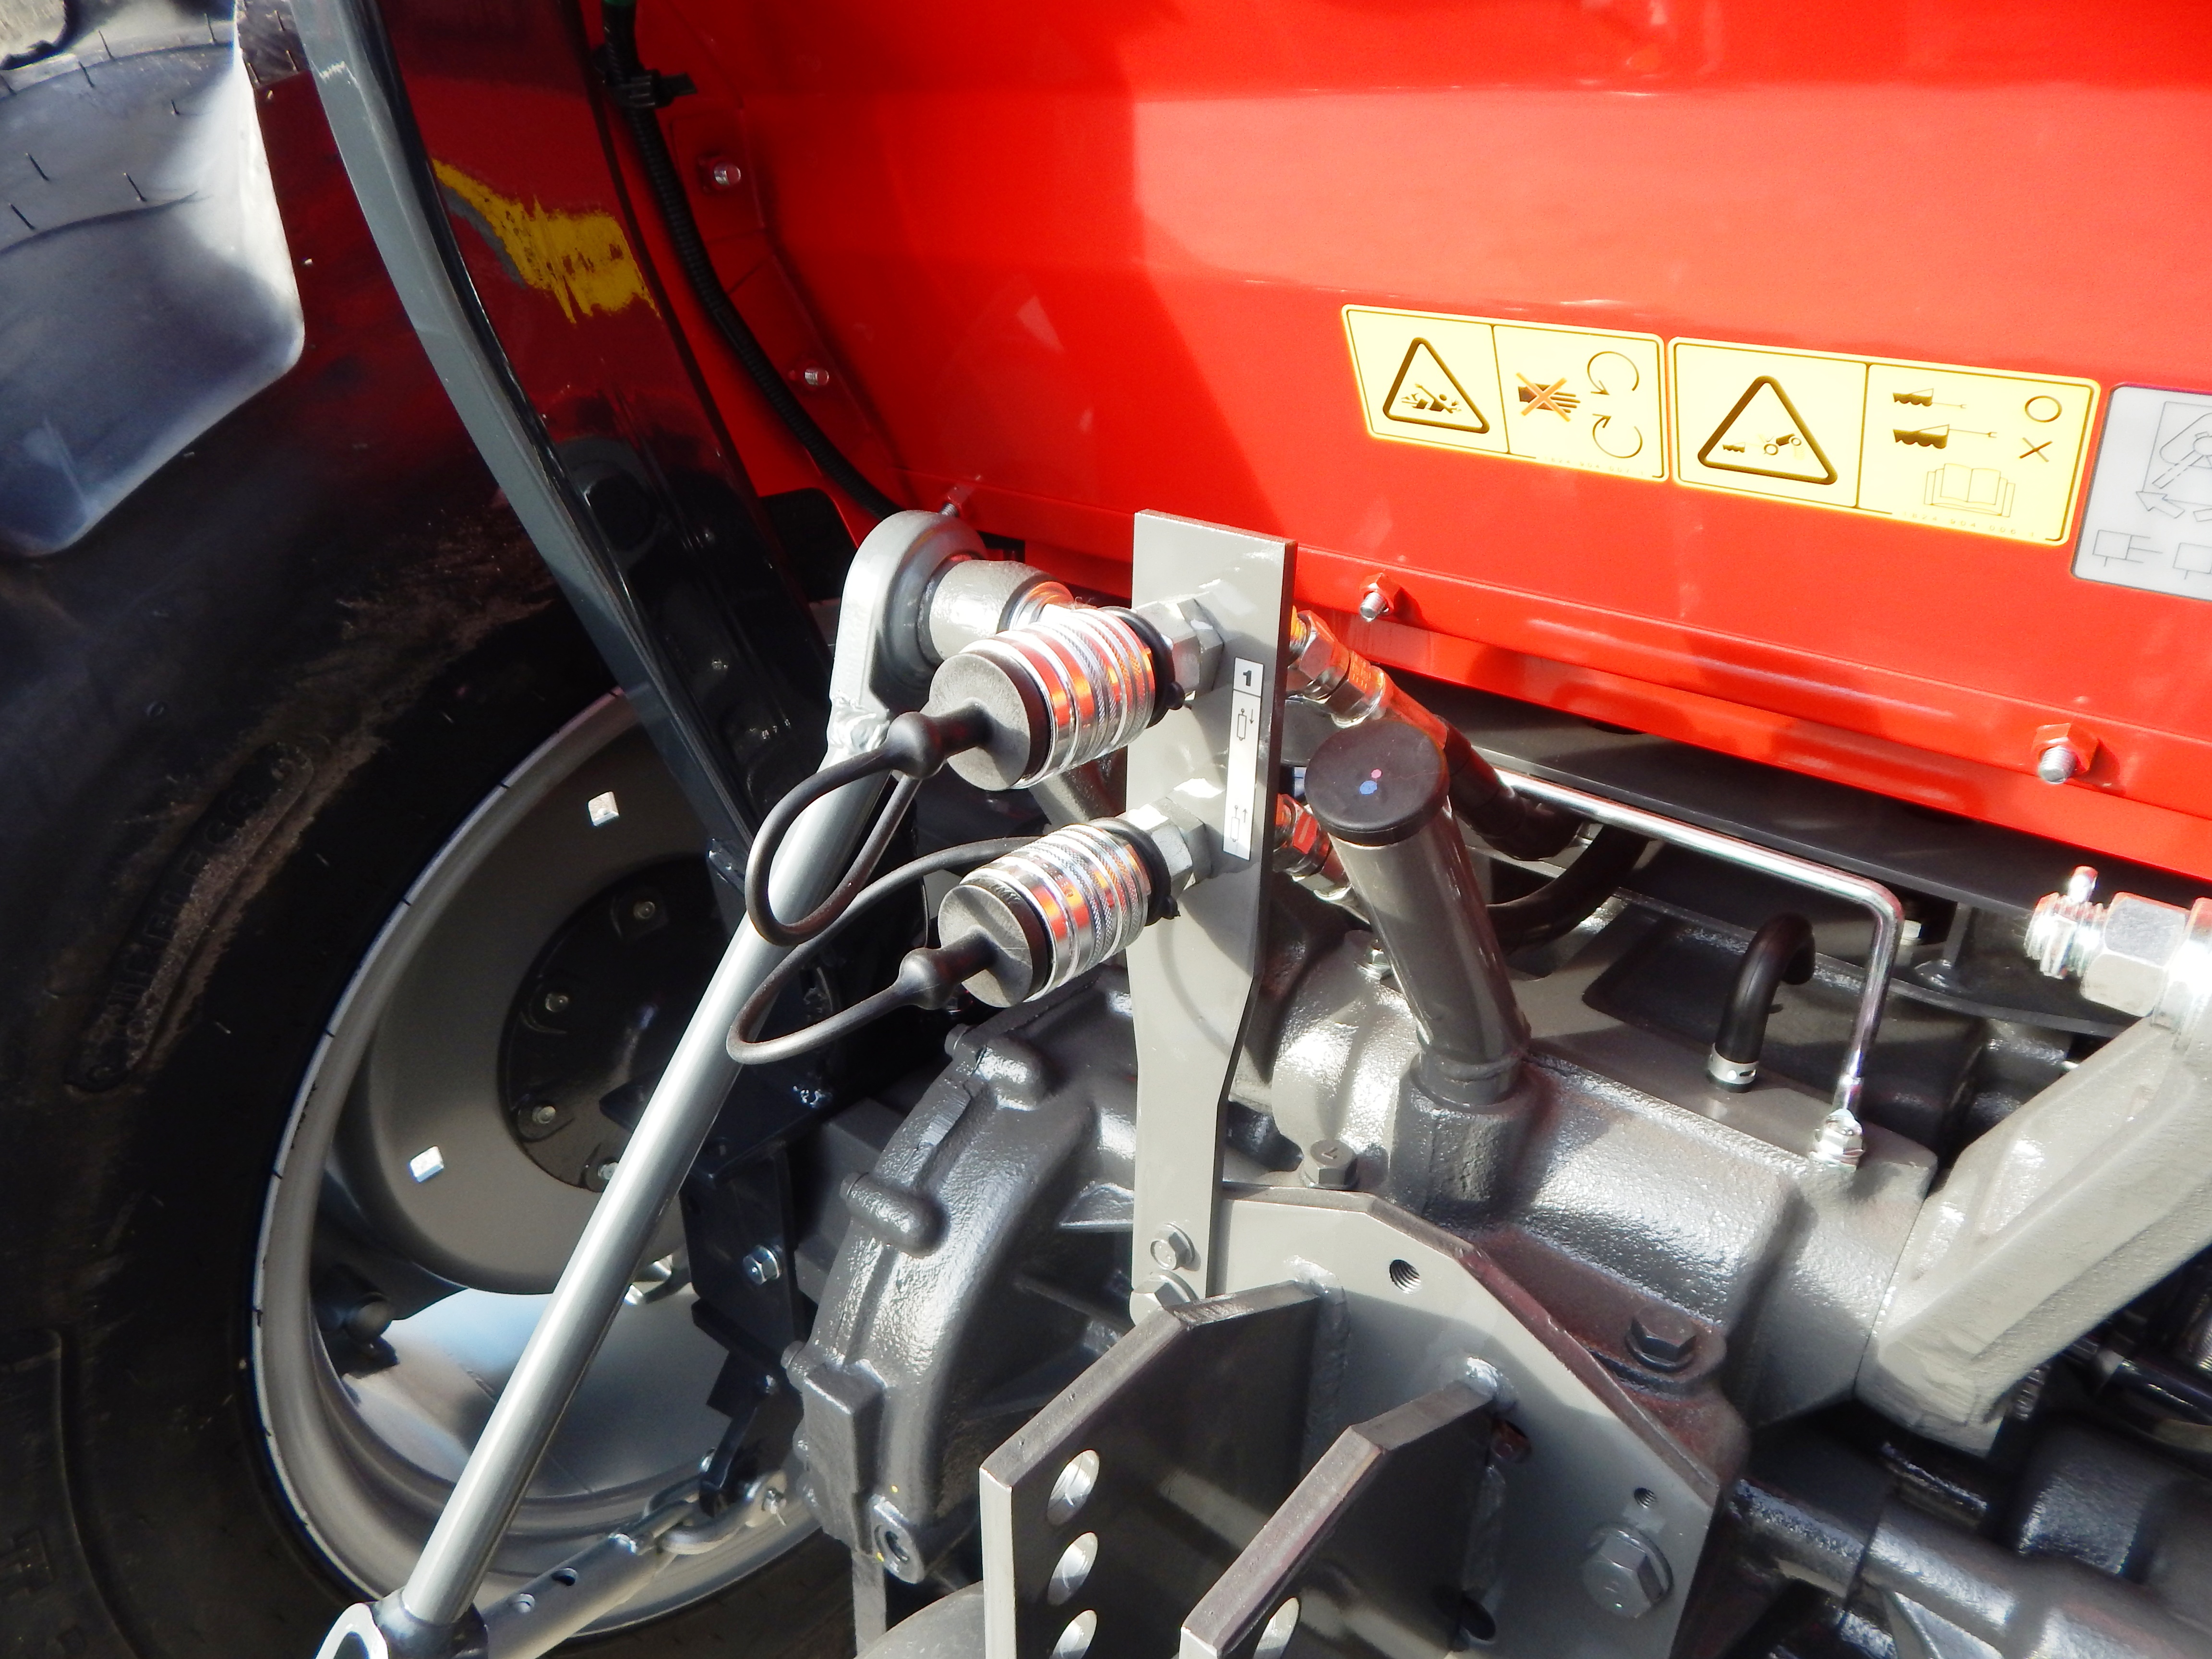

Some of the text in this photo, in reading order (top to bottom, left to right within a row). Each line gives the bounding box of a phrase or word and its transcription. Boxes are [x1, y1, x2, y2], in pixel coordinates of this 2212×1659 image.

[1903, 511, 1937, 521] 1824
[1950, 518, 1976, 528] 904
[1989, 525, 2016, 535] 006
[1242, 670, 1252, 686] 1
